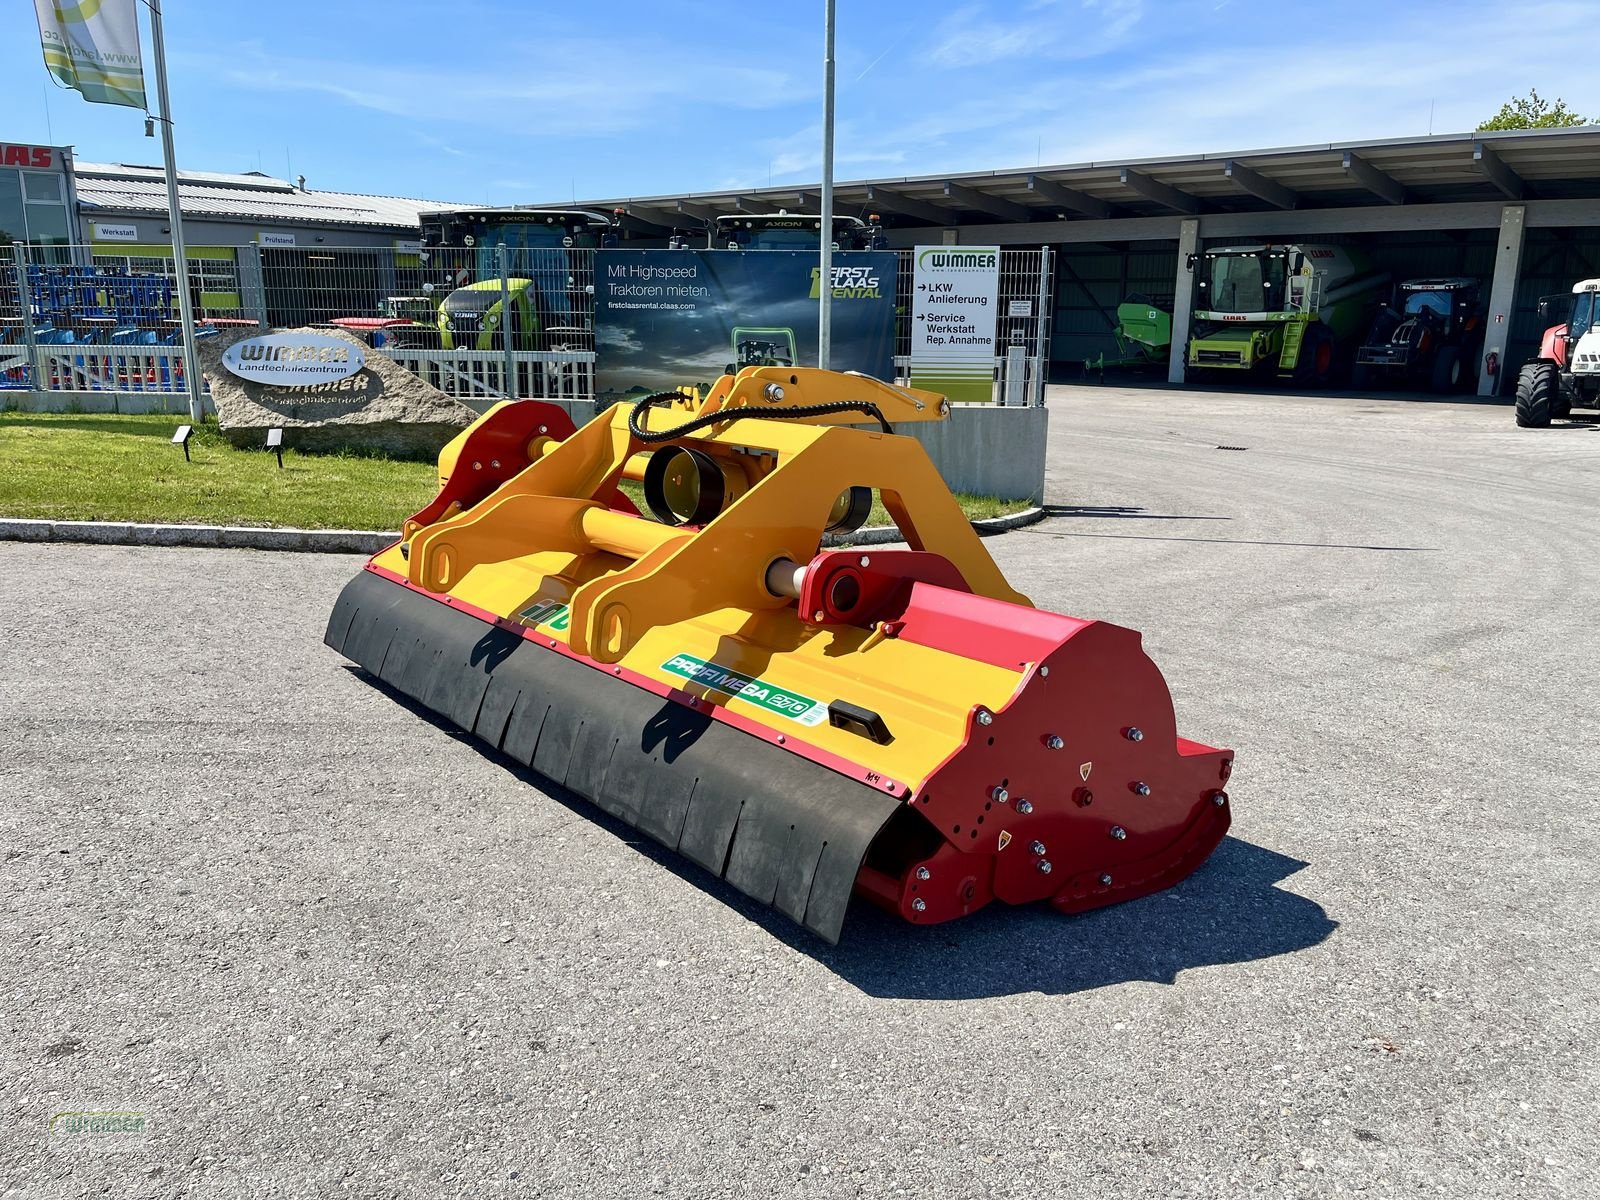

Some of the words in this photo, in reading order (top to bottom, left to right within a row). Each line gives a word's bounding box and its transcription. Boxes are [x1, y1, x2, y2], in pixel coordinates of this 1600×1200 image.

[0, 145, 52, 167] AS
[101, 228, 136, 237] Werkstatt
[265, 236, 294, 244] Prüfstand
[932, 254, 996, 268] WIMMER
[608, 264, 626, 278] Mit
[630, 264, 697, 280] Highspeed
[608, 283, 663, 296] Traktoren
[666, 284, 711, 297] mieten.
[830, 288, 882, 299] ENTAL
[928, 283, 953, 293] LKW
[608, 302, 696, 310] firstclaasrental.claas.com
[928, 295, 988, 306] Anlieferung
[927, 313, 966, 322] Service
[927, 325, 976, 334] Werkstatt
[926, 336, 947, 346] Rep.
[949, 335, 992, 345] Annahme
[238, 363, 347, 374] Landtechnikzentrum
[667, 657, 716, 681] PROFI
[716, 674, 771, 701] MEGA
[766, 693, 810, 714] 270
